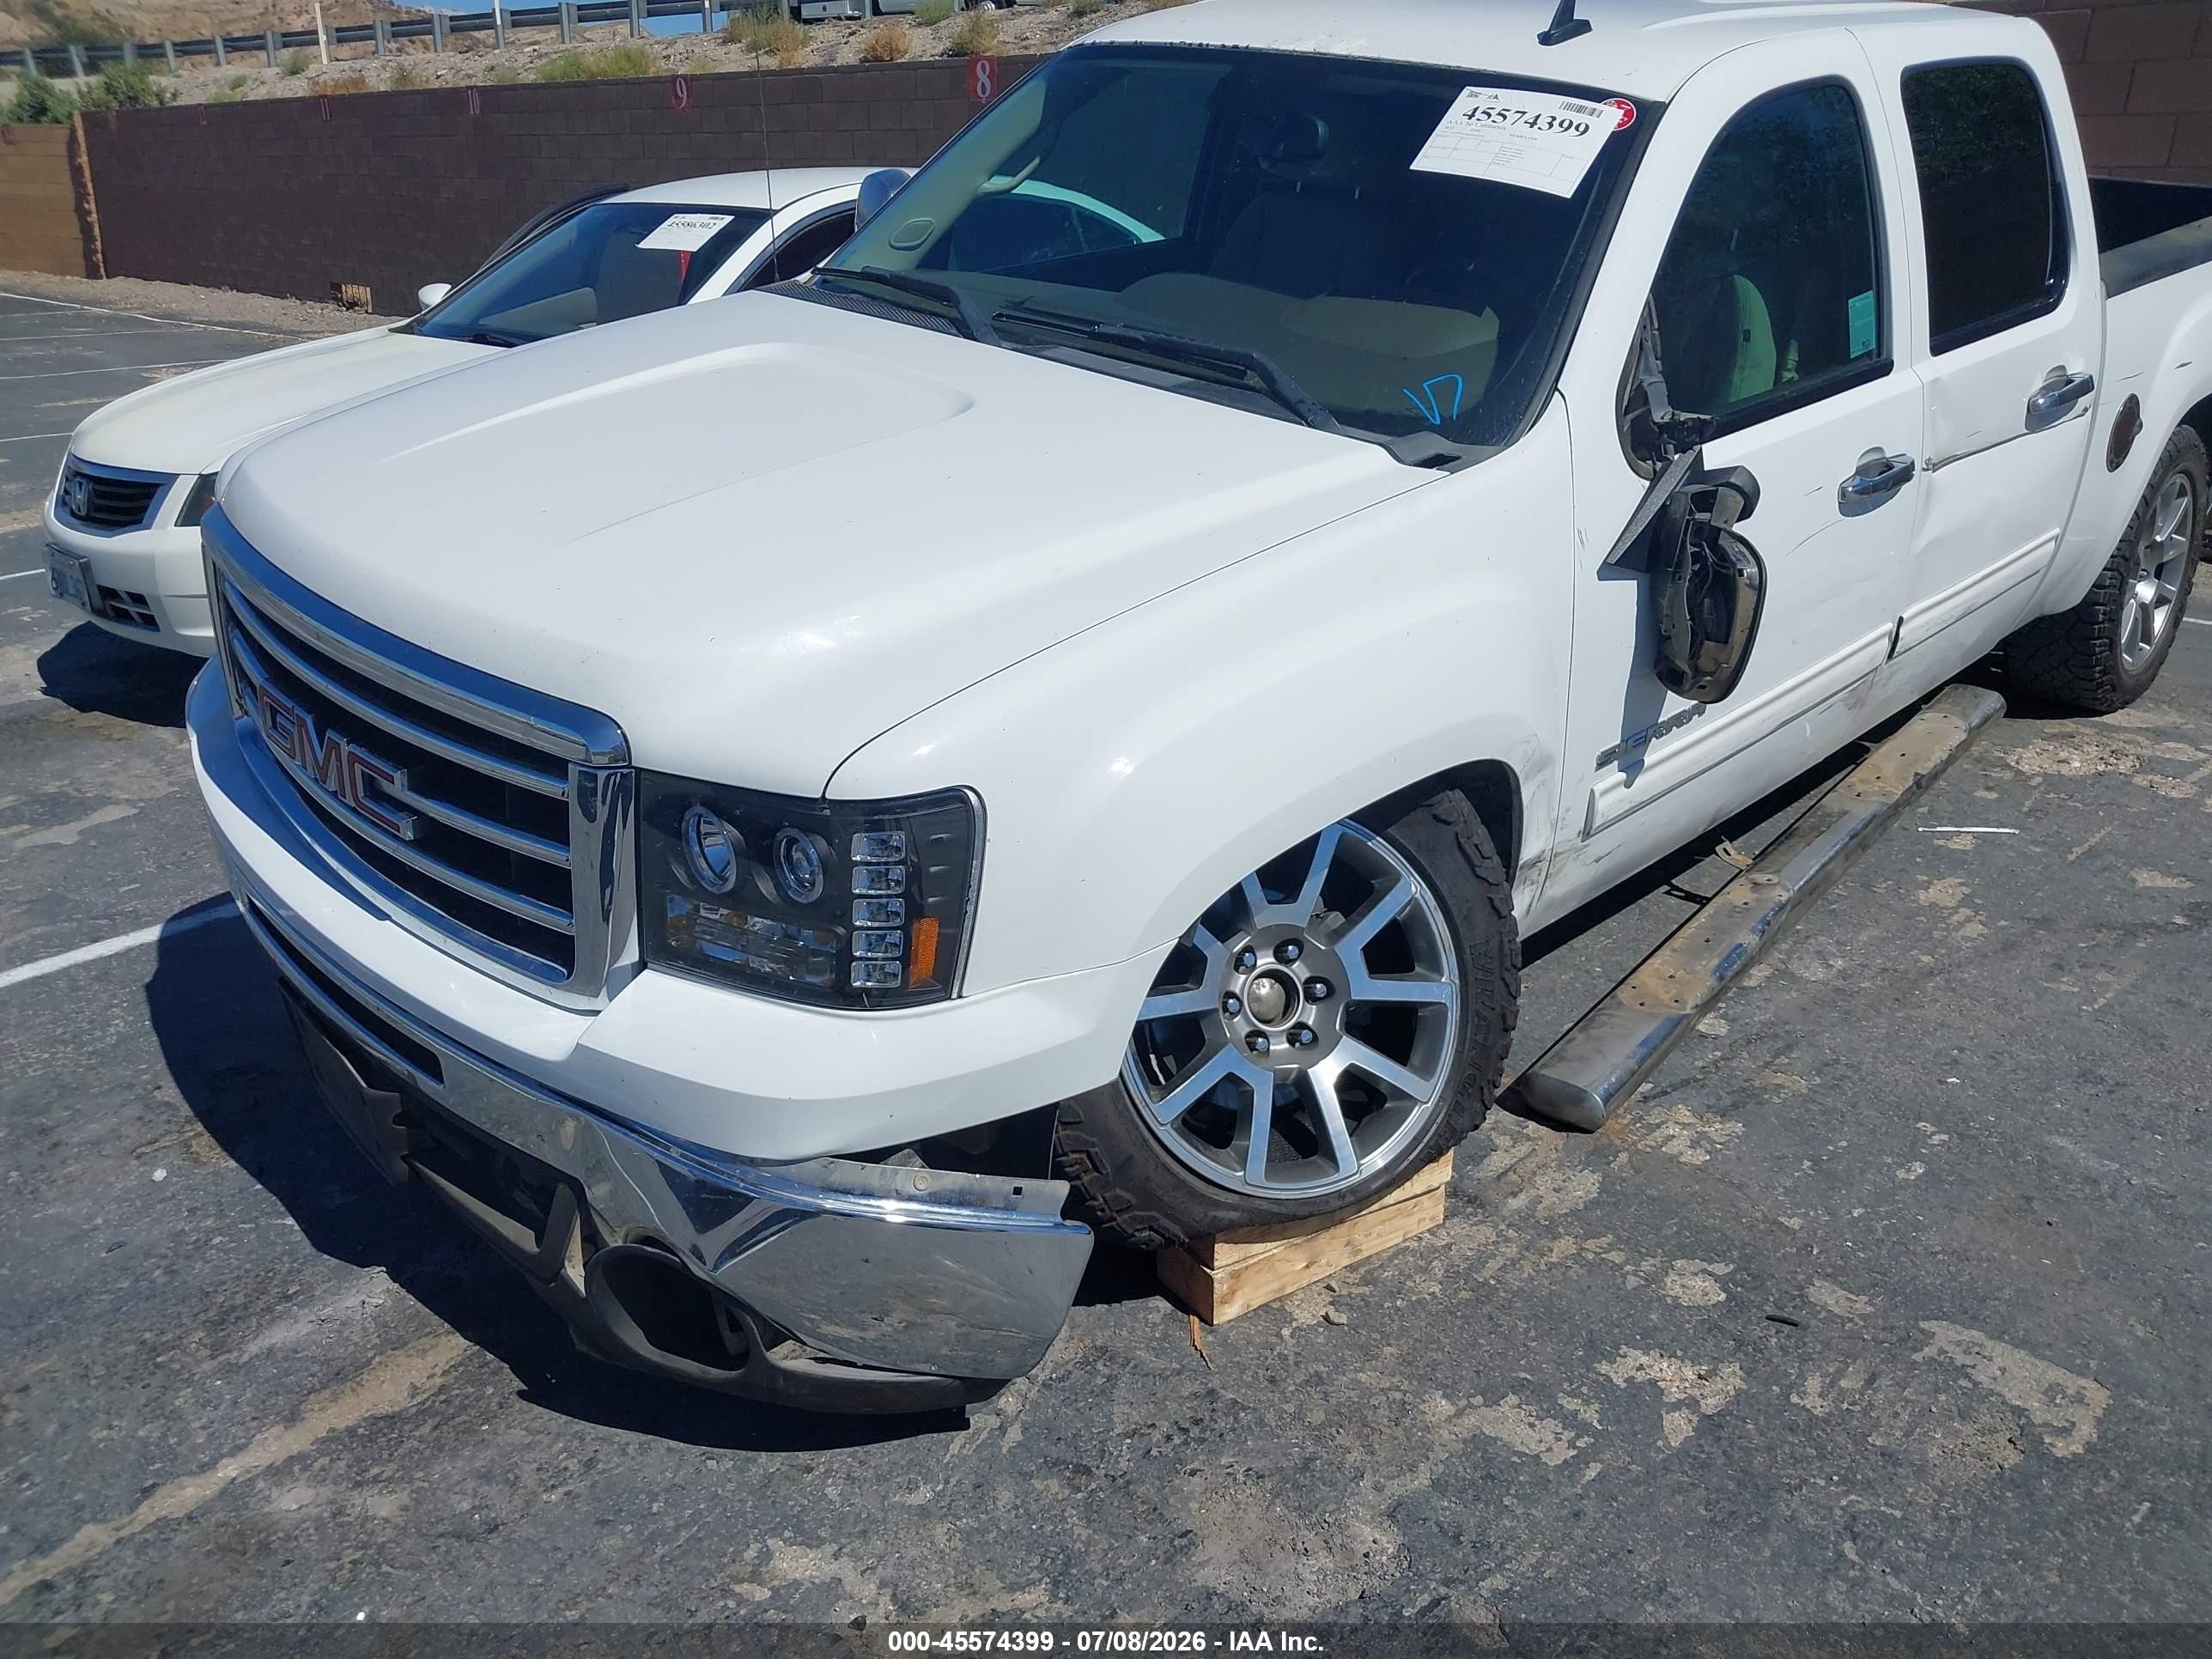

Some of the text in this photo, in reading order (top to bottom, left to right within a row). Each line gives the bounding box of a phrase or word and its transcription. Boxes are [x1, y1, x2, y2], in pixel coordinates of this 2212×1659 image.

[676, 77, 687, 109] 9
[975, 59, 991, 98] 8
[1462, 105, 1589, 137] 45574399
[1595, 702, 1707, 771] SIERRA
[258, 679, 417, 842] GMC
